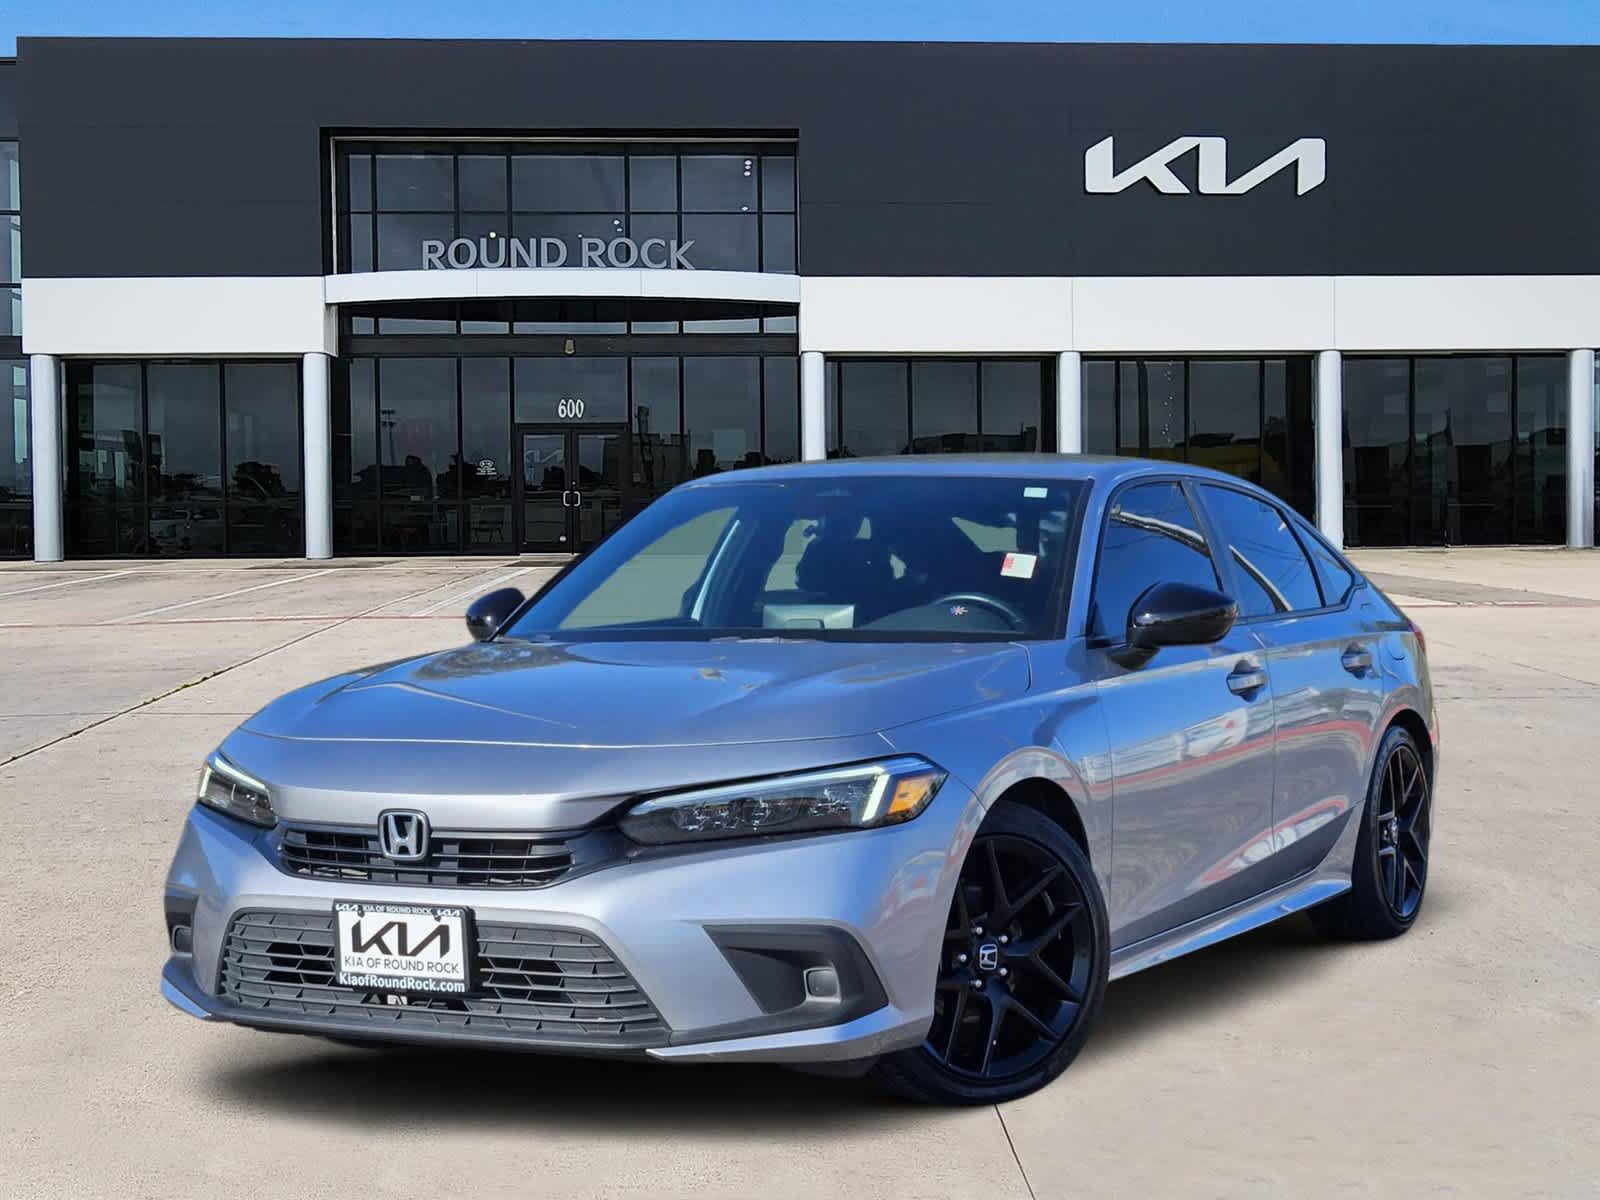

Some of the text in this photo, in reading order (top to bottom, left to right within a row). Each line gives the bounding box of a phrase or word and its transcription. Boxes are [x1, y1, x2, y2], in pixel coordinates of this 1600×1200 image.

[1085, 135, 1326, 196] KIA
[422, 237, 695, 270] ROUND ROCK
[558, 399, 584, 418] 600
[351, 919, 450, 959] KIA
[344, 956, 460, 974] KIA OF ROUND ROCK
[339, 971, 465, 992] KiaofRoundRock.com
